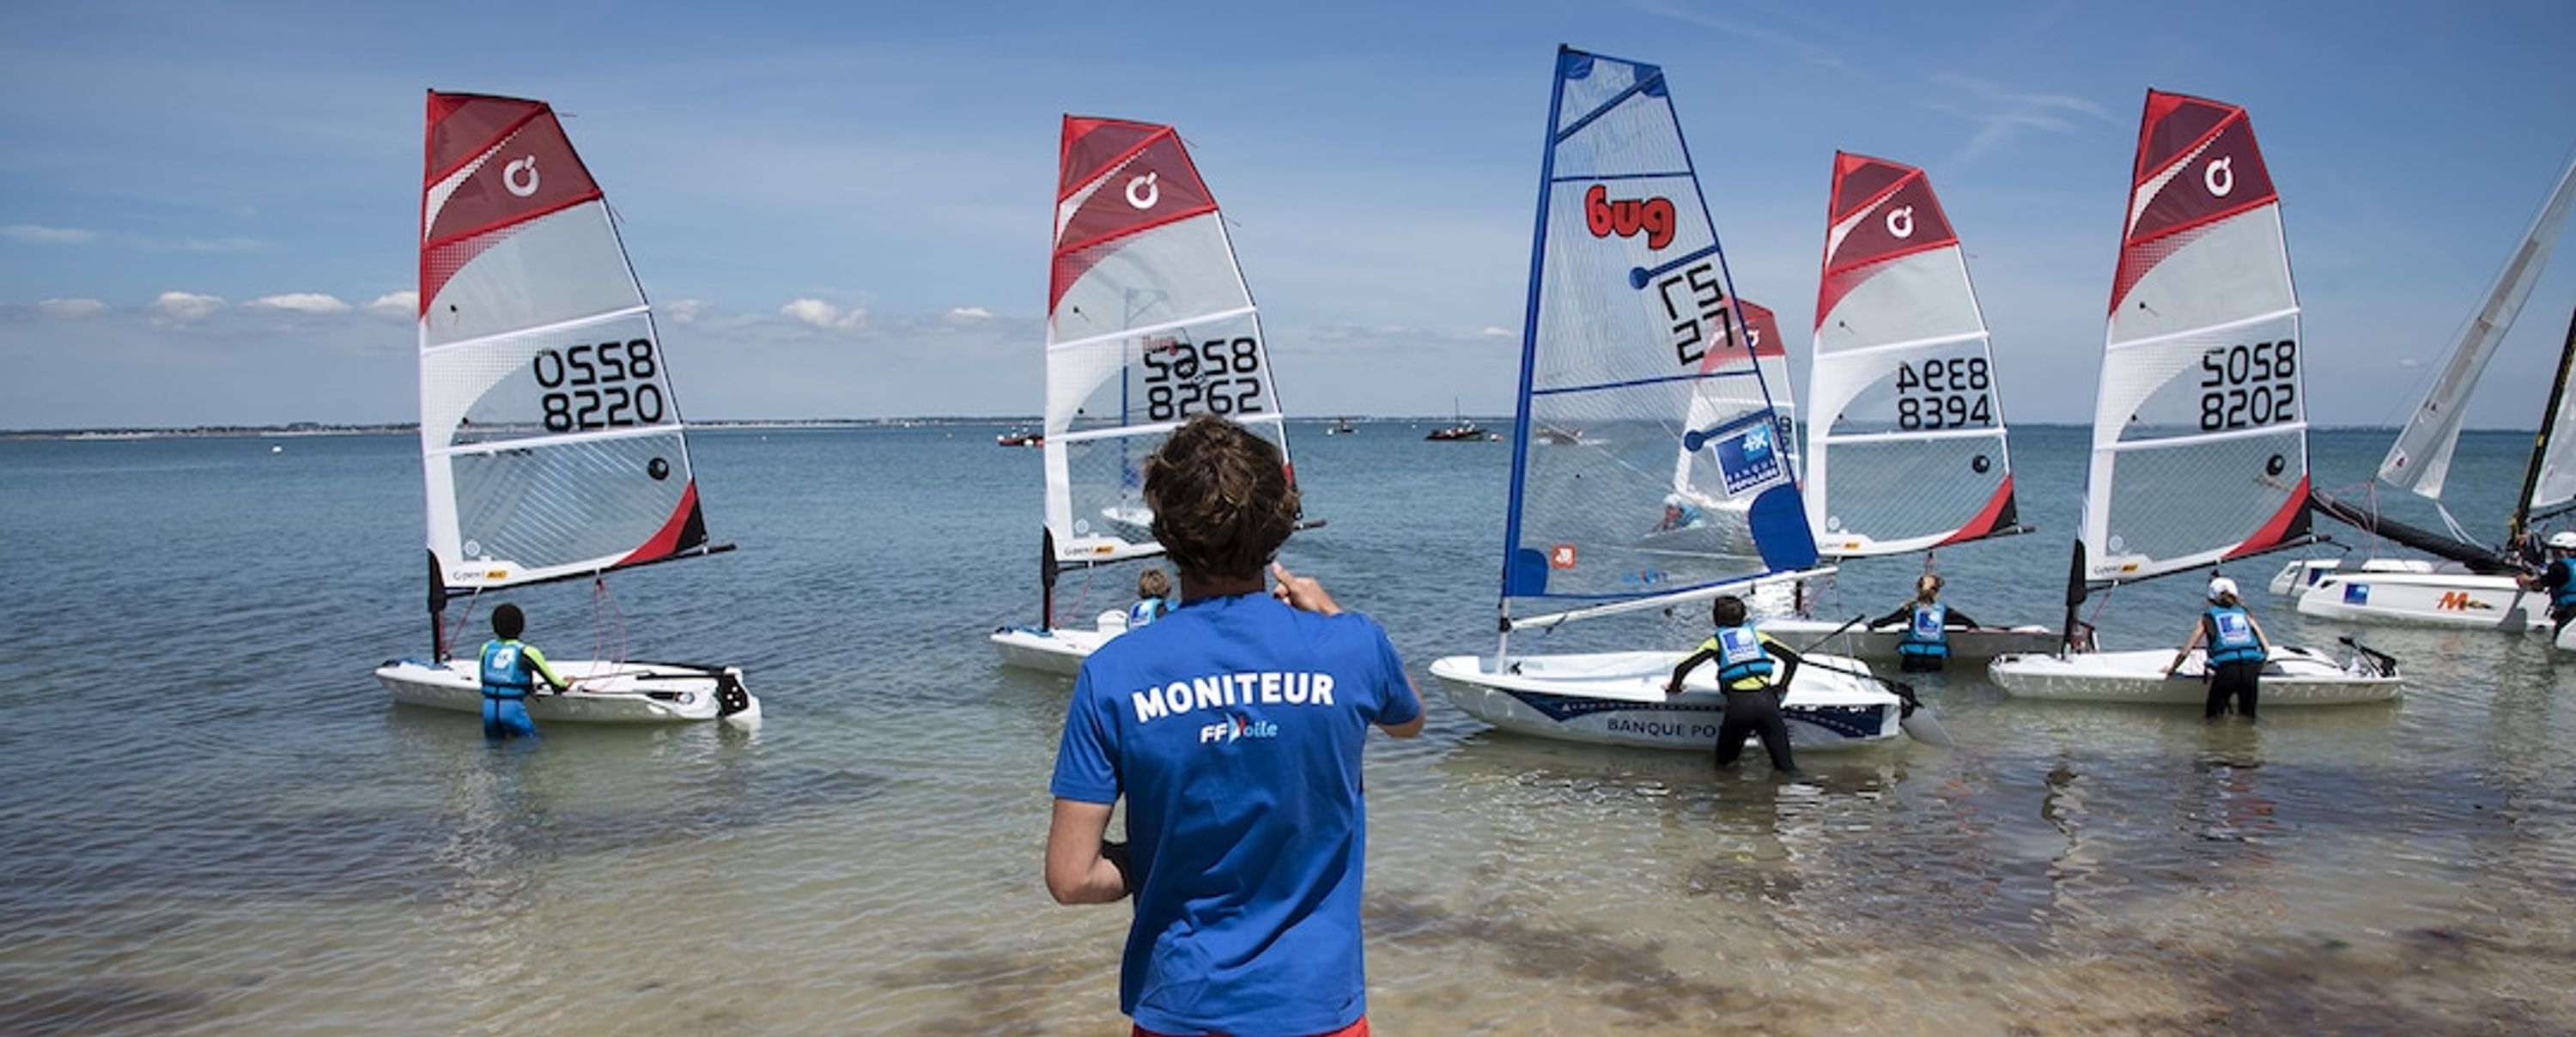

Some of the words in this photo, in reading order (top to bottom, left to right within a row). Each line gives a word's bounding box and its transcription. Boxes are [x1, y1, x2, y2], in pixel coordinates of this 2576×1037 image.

[1584, 184, 1675, 251] bug
[542, 384, 663, 432] 8220
[1148, 377, 1262, 421] 8262
[1899, 394, 1991, 430] 8394
[2201, 384, 2294, 430] 8202
[1132, 672, 1334, 723] MONITEUR
[1607, 718, 1682, 738] BANQUE
